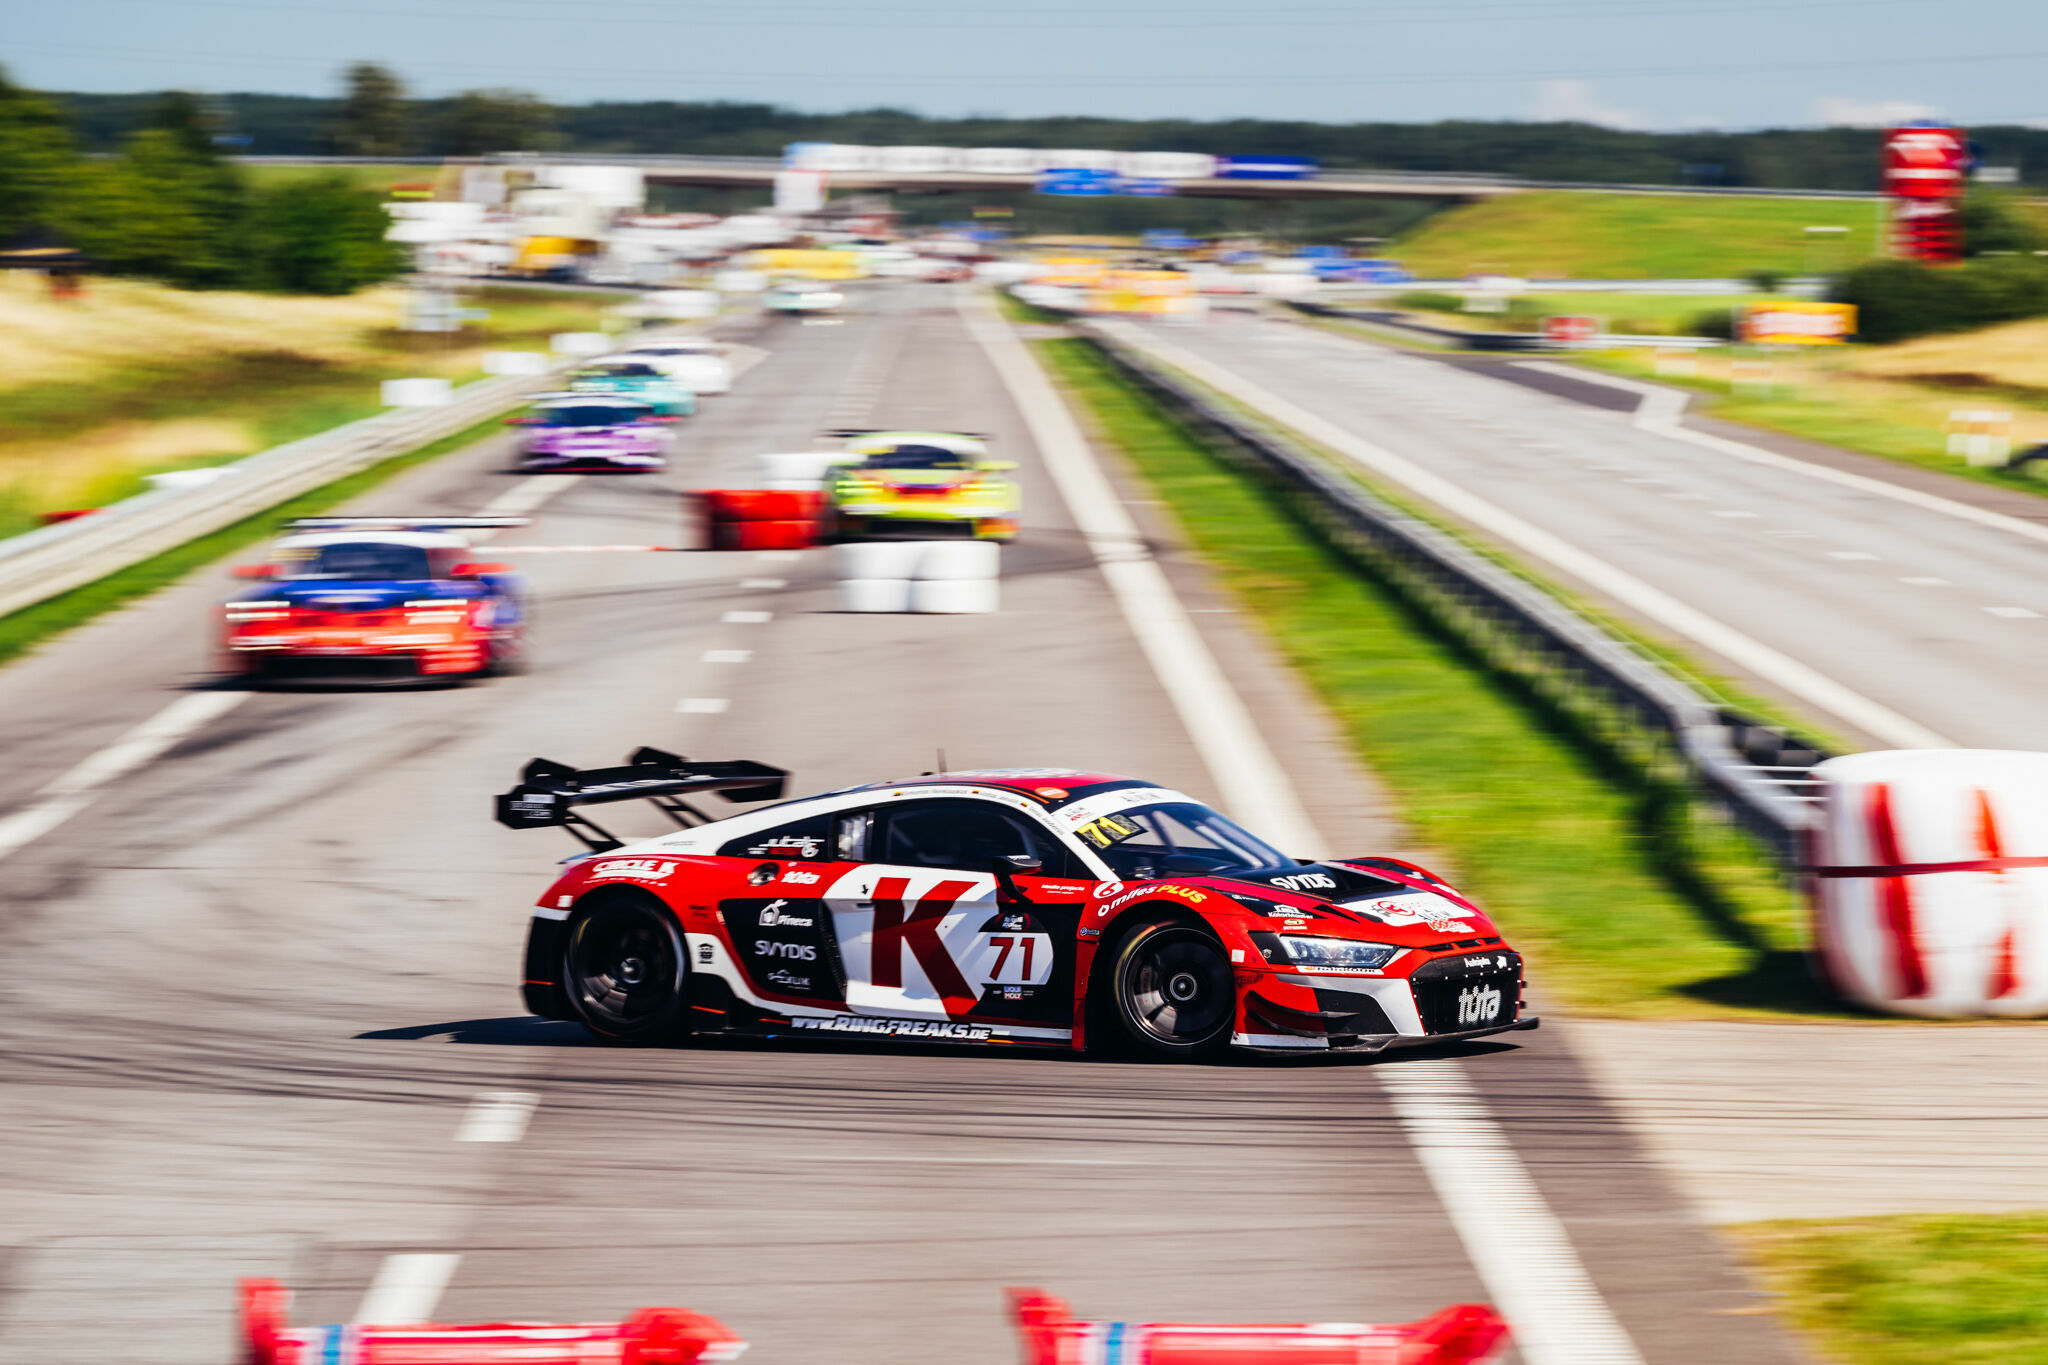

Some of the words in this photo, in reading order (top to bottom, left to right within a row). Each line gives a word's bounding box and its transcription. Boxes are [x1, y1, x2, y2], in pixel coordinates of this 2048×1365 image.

[1076, 816, 1131, 845] 71
[754, 940, 817, 961] SVYDIS
[871, 877, 980, 1015] K
[989, 937, 1035, 981] 71
